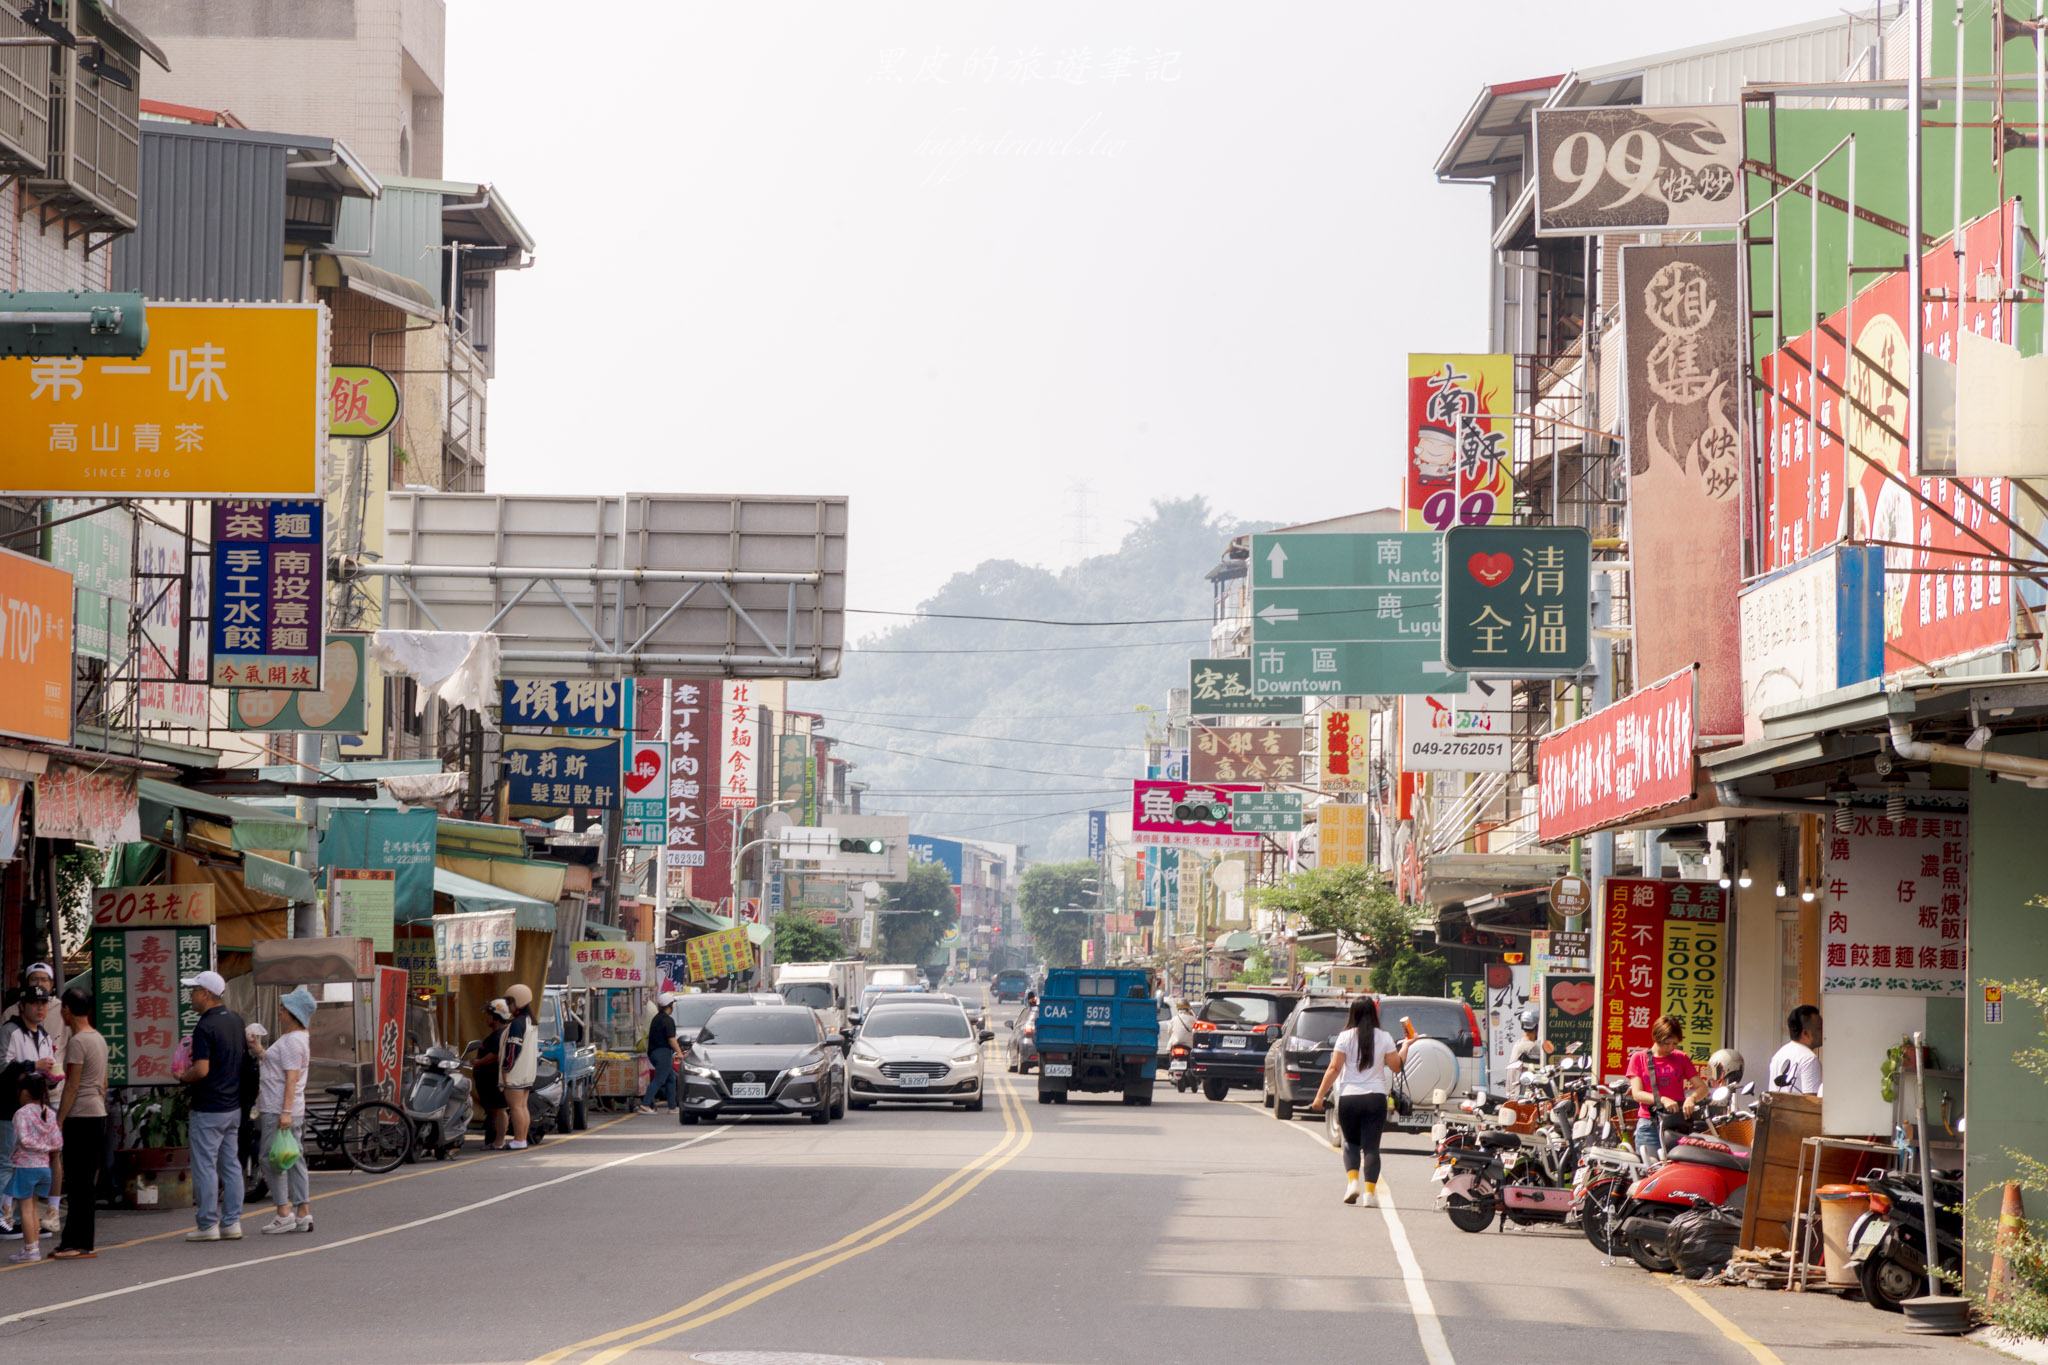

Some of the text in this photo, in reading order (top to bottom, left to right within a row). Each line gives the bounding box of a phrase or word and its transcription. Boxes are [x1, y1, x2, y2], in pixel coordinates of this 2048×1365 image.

[1544, 130, 1661, 212] 99
[1664, 167, 1733, 201] 快炒
[30, 343, 228, 401] 第一味
[48, 423, 204, 452] 高山青茶
[84, 468, 171, 478] SINCE 2006
[1703, 427, 1738, 499] 快炒
[1423, 489, 1496, 531] 99
[223, 550, 262, 650] 手工水餃
[272, 550, 311, 650] 南投意麵
[1259, 648, 1337, 673] 市區
[218, 665, 313, 686] 冷氣開放
[1257, 678, 1342, 693] Downtown
[1412, 742, 1503, 756] 049-2762051
[509, 751, 588, 779] 凱莉斯
[669, 683, 701, 846] 老丁牛肉麵水餃
[531, 782, 613, 806] 髮型設計
[627, 827, 643, 838] ATM
[95, 892, 205, 924] 20年老店
[1670, 885, 1720, 904] 合菜
[1554, 945, 1586, 957] 5.5Km
[1608, 885, 1629, 991] 百分之九十八
[576, 948, 617, 962] 香蕉酥
[601, 967, 641, 981] 杏鮑菇
[129, 935, 176, 1079] 嘉義雞肉飯
[1045, 1005, 1110, 1019] CAA- 5673
[1549, 1020, 1576, 1028] CHING
[1605, 998, 1626, 1069] 包君滿意
